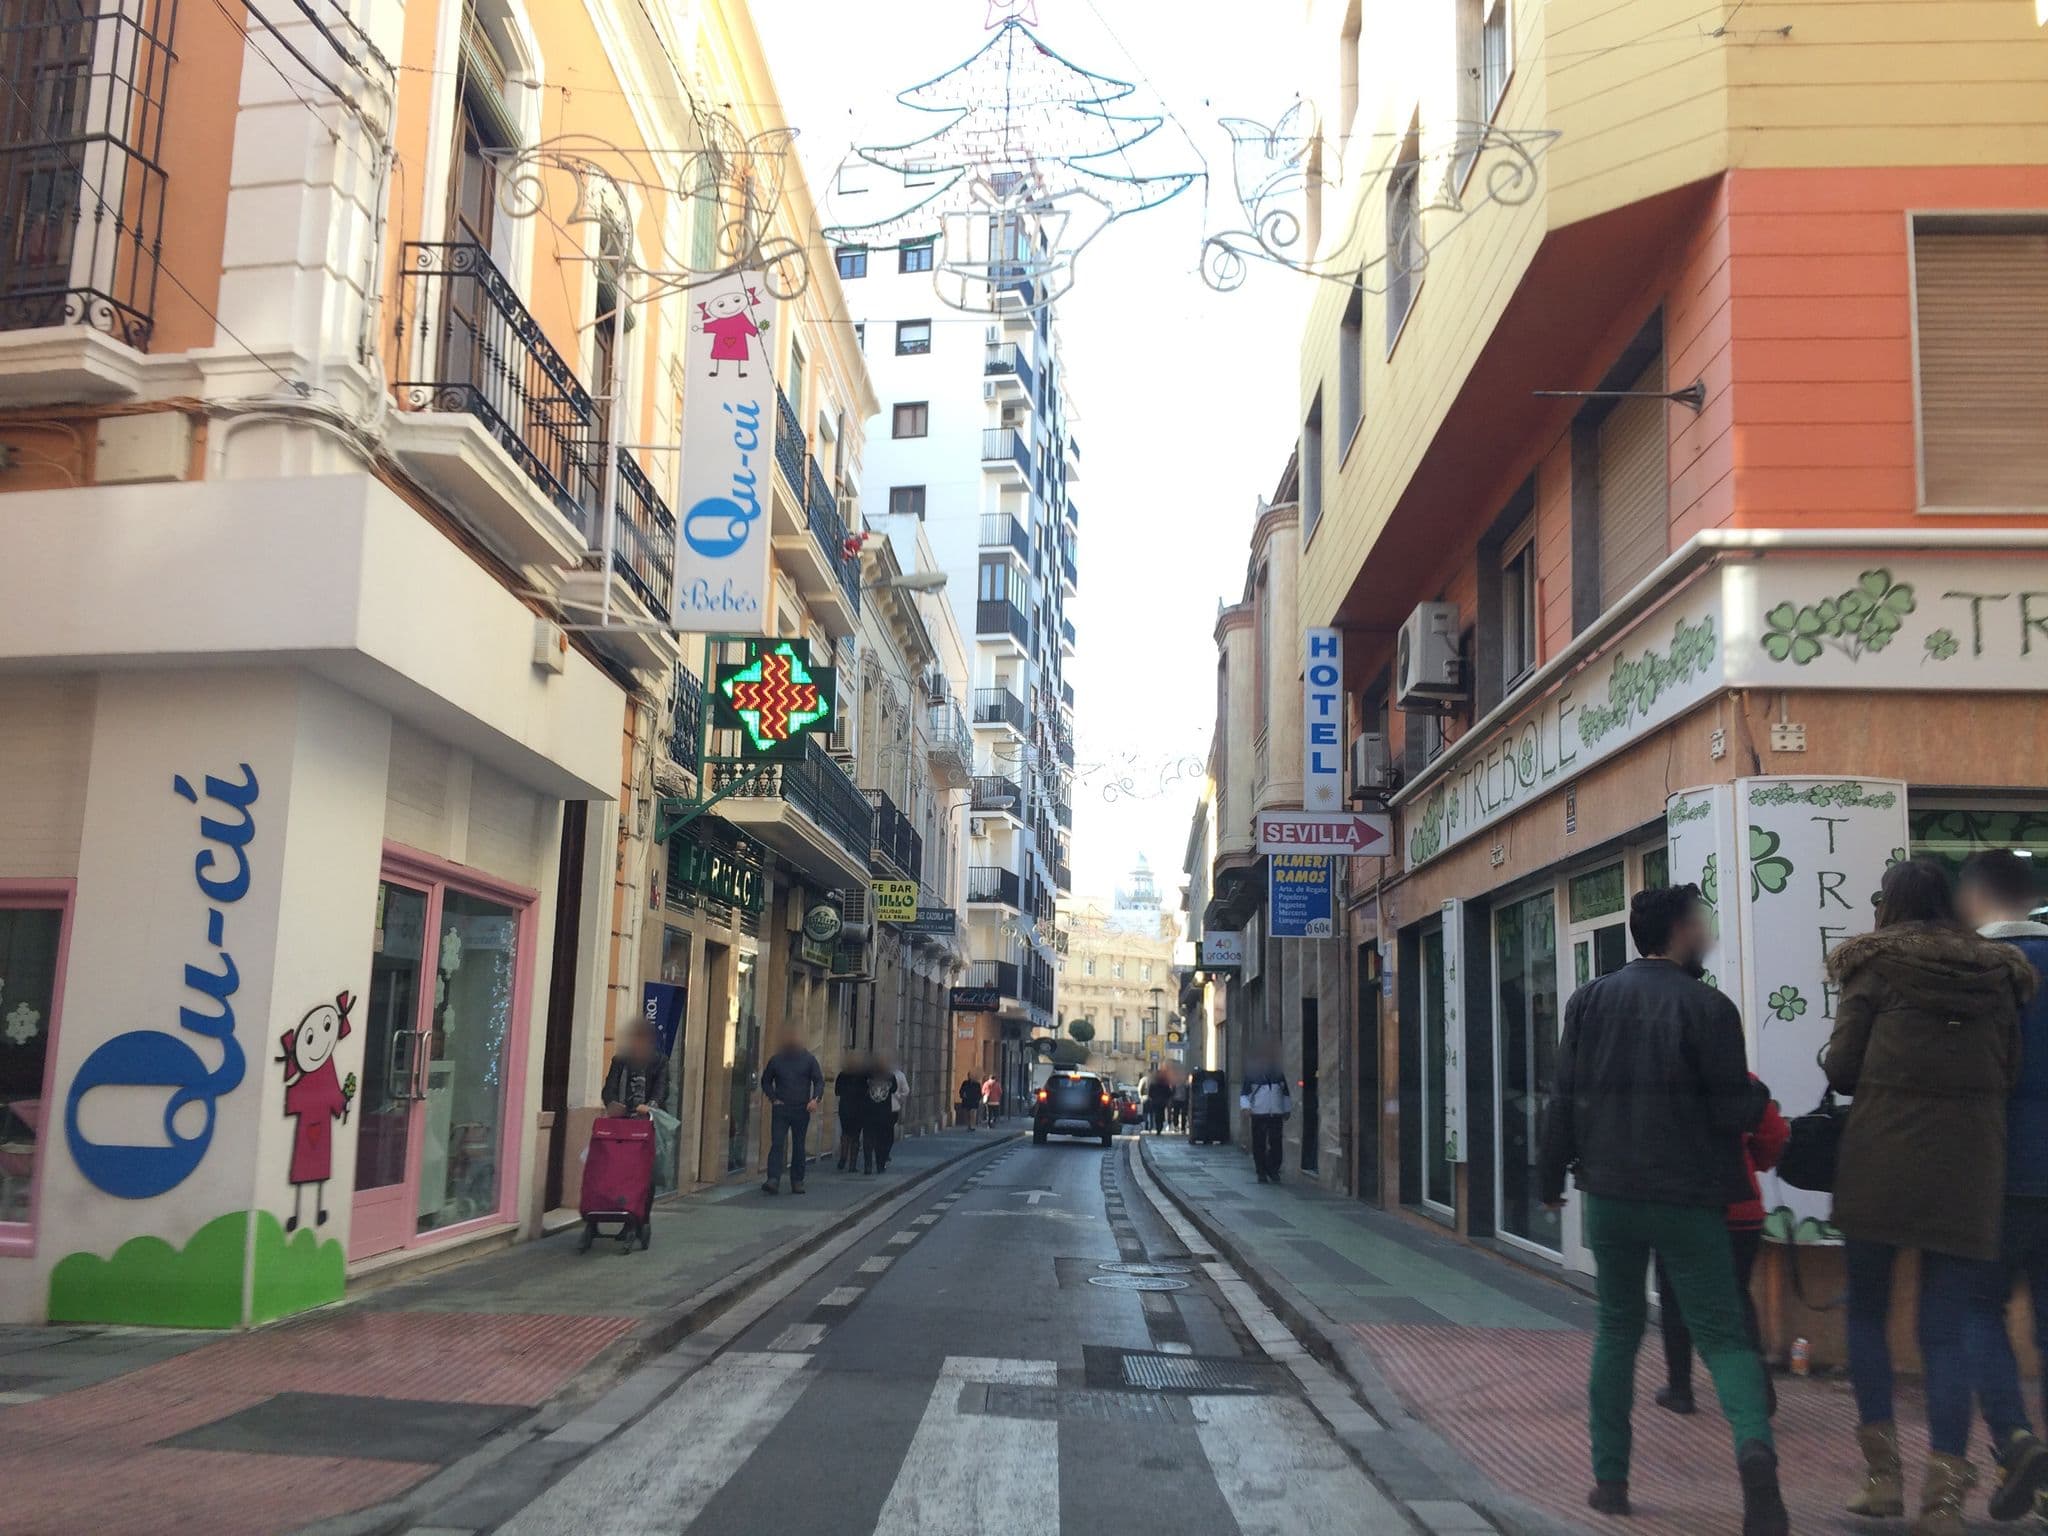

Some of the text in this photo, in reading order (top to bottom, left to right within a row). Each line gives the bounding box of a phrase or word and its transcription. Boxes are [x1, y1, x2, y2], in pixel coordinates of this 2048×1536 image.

[684, 400, 761, 558] Qu-cú
[681, 577, 758, 614] Bebés
[1310, 637, 1338, 774] HOTEL
[1459, 690, 1577, 830] TREBOLE
[1267, 824, 1360, 844] SEVILLA
[890, 884, 912, 893] BAR
[1276, 870, 1326, 883] RAMOS
[1206, 951, 1242, 961] grados
[1215, 938, 1233, 949] 40
[65, 762, 259, 1200] Qu-cú
